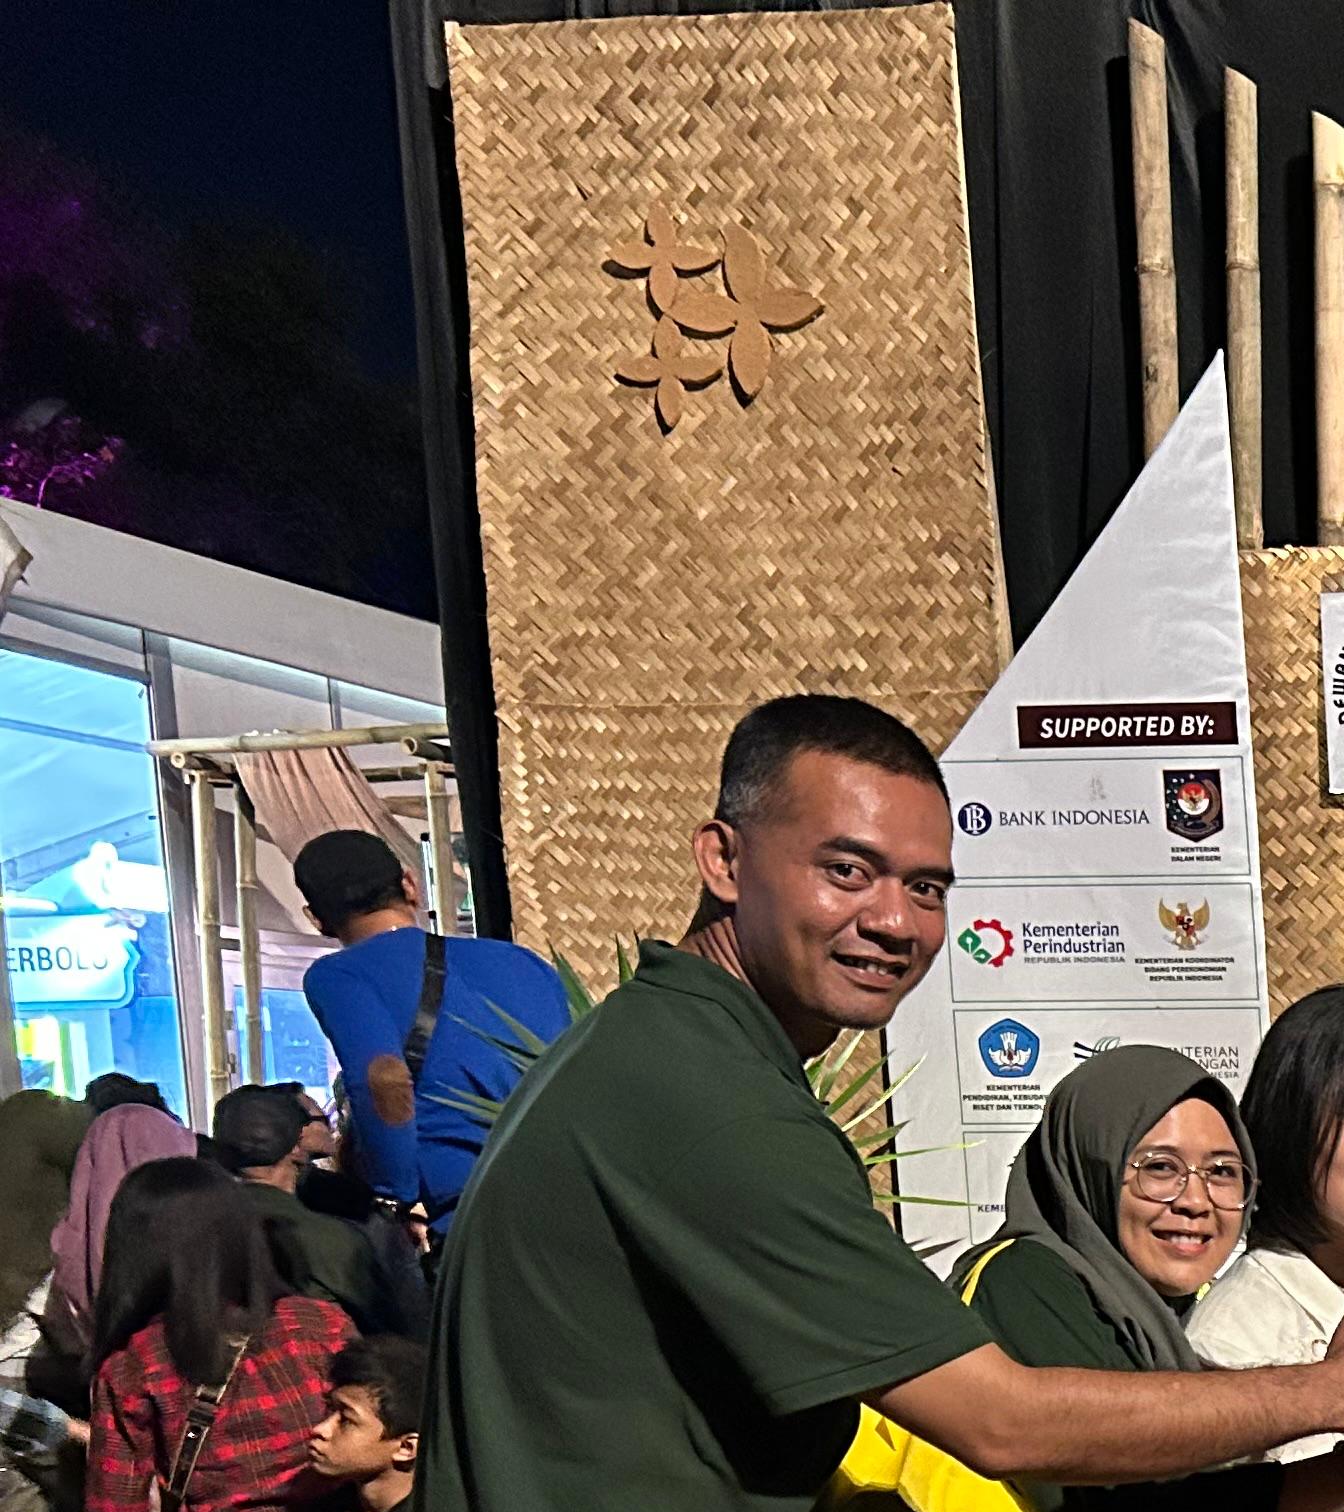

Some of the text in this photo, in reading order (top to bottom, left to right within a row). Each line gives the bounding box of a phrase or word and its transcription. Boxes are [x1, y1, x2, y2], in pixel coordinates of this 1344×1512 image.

[1040, 715, 1215, 739] SUPPORTED BY:
[999, 809, 1150, 827] BANK INDONESIA
[1022, 920, 1120, 937] Kementerian
[1023, 937, 1126, 954] Perindustrian
